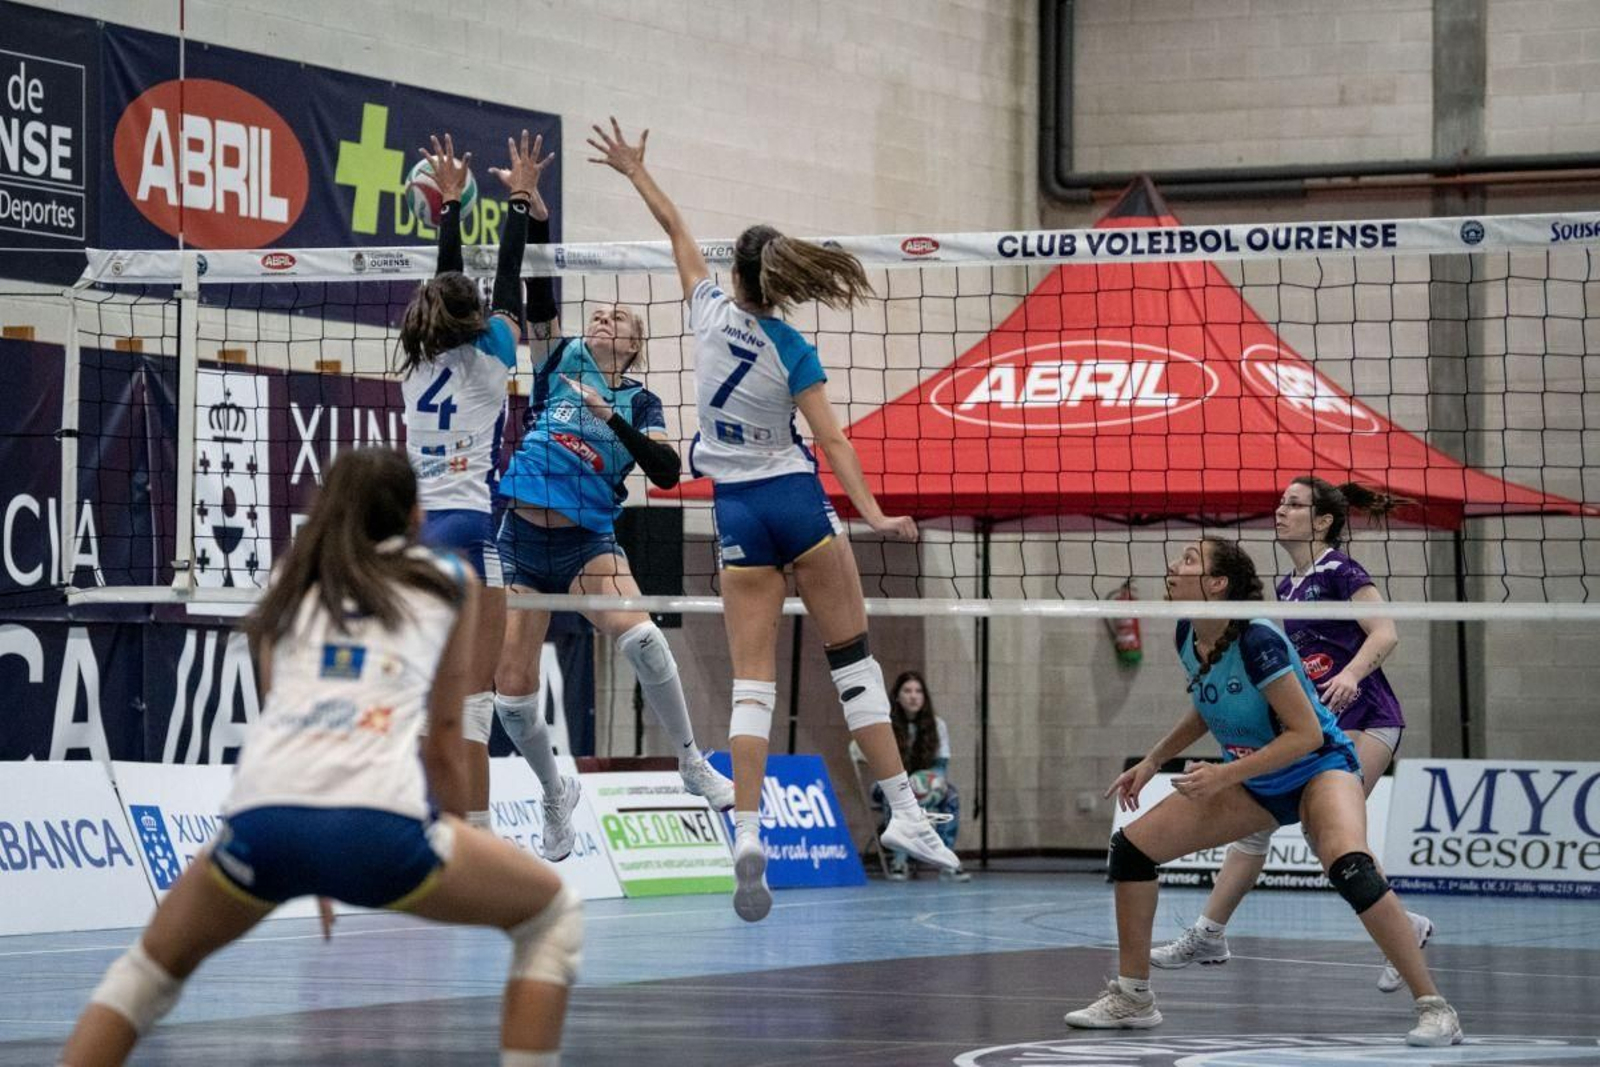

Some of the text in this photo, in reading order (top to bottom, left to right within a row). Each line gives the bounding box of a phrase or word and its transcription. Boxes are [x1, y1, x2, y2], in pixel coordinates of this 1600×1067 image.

[7, 61, 45, 114] de
[136, 106, 290, 223] ABRIL
[0, 189, 76, 228] Deportes
[370, 259, 411, 268] OURENSE
[996, 222, 1398, 259] CLUB VOLEIBOL OURENSE
[416, 366, 458, 430] 4
[709, 342, 758, 410] 7
[958, 360, 1181, 412] ABRIL
[3, 493, 106, 587] CIA
[490, 800, 541, 827] XUNT
[0, 818, 134, 871] BANCA
